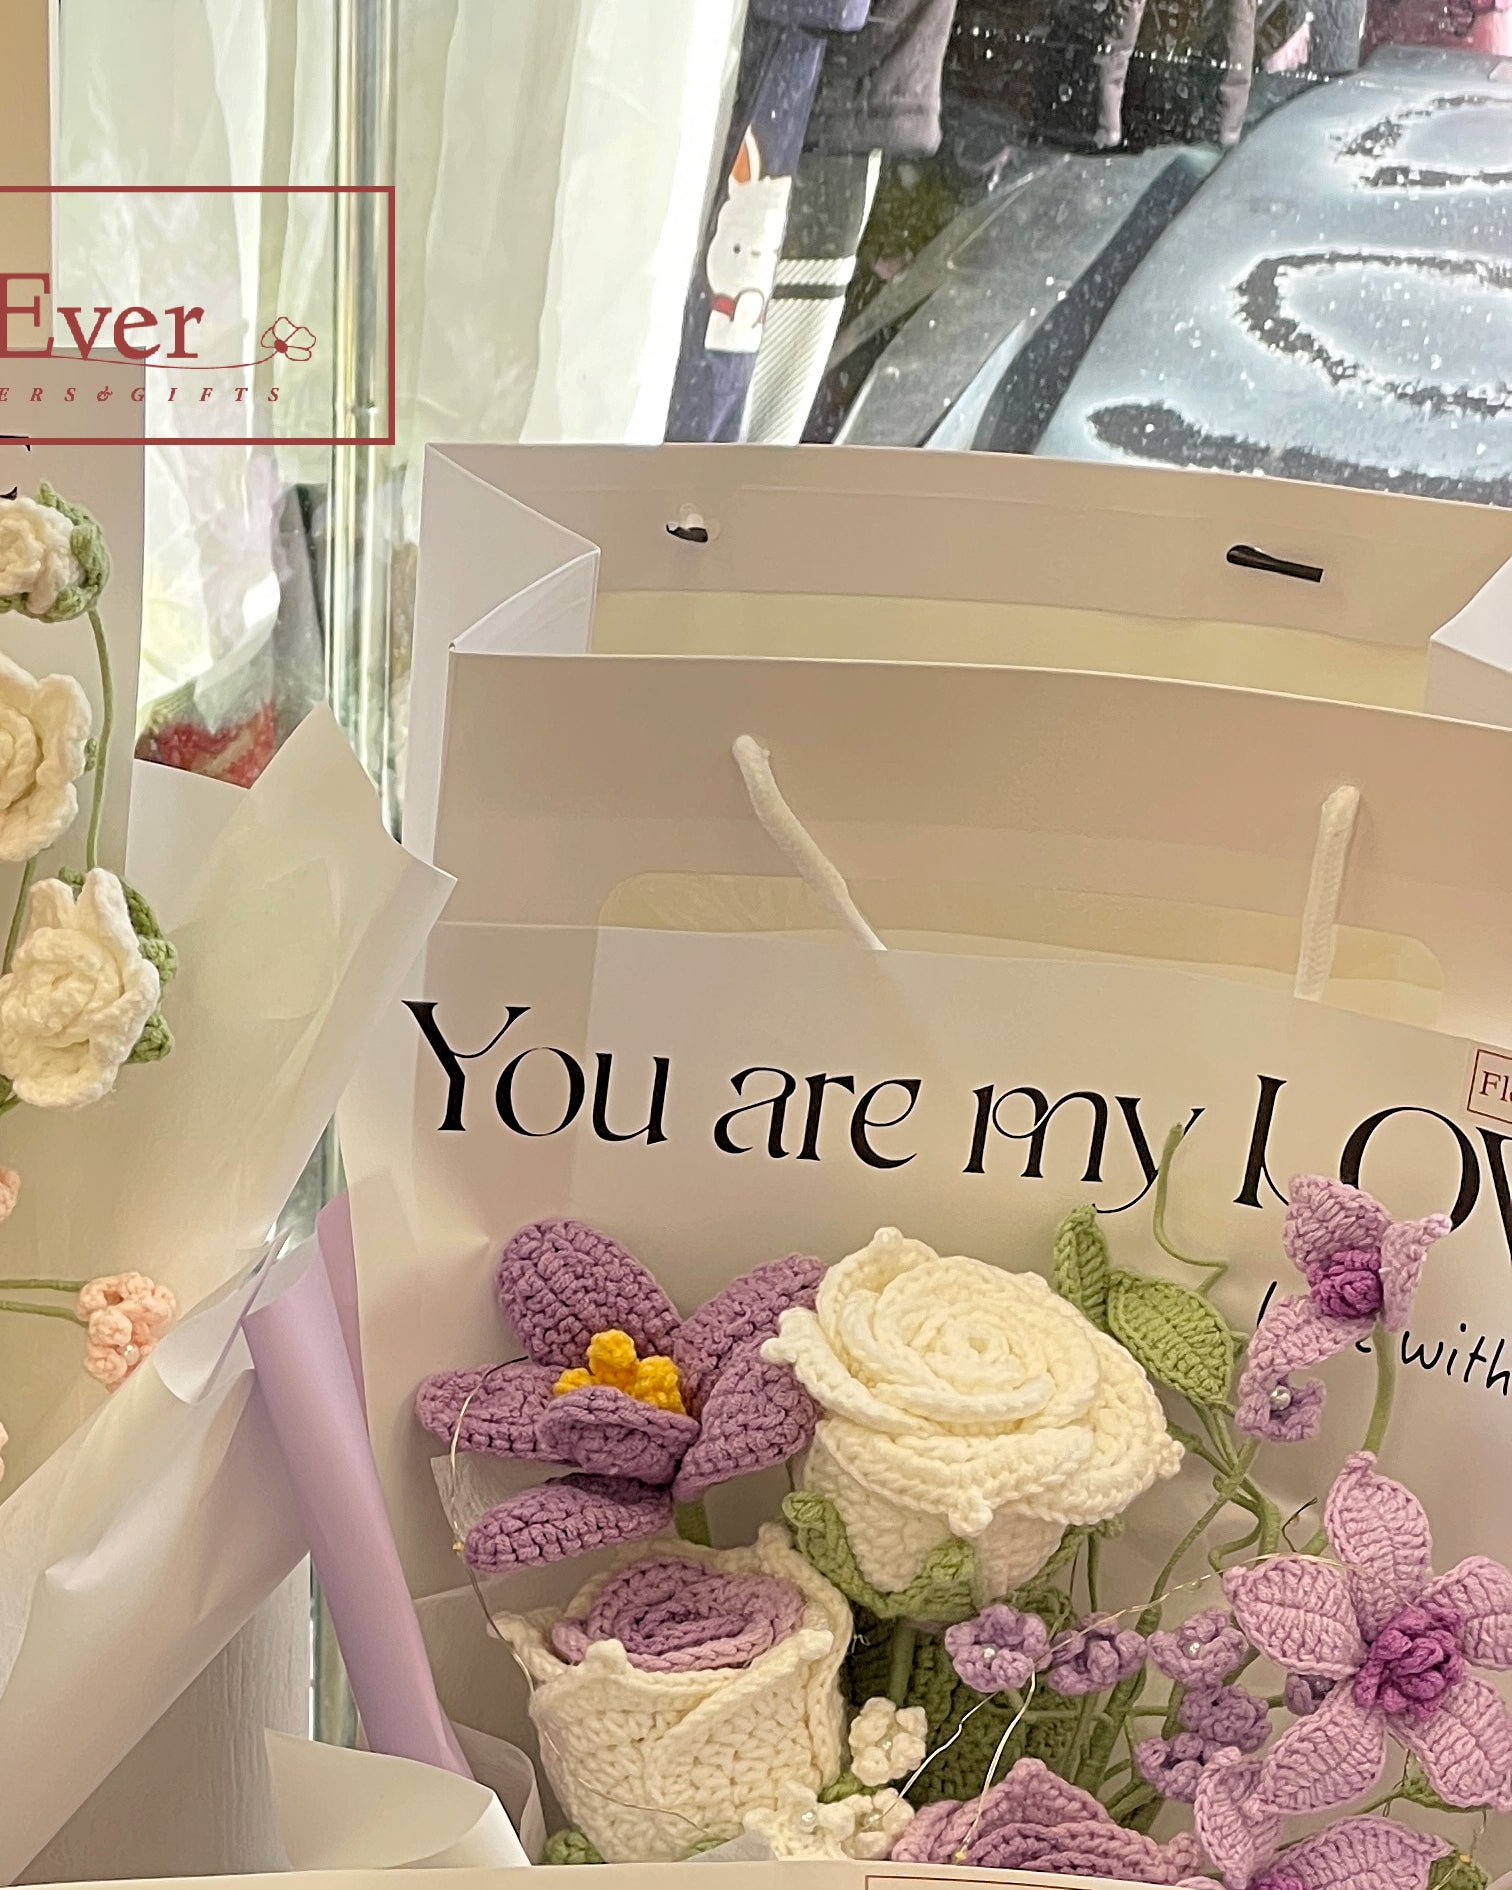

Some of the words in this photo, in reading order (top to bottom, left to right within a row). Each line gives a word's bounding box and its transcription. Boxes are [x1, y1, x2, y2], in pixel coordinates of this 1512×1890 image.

[401, 998, 671, 1146] You
[713, 1065, 922, 1170] are
[963, 1083, 1205, 1215] my
[1402, 1323, 1511, 1397] with
